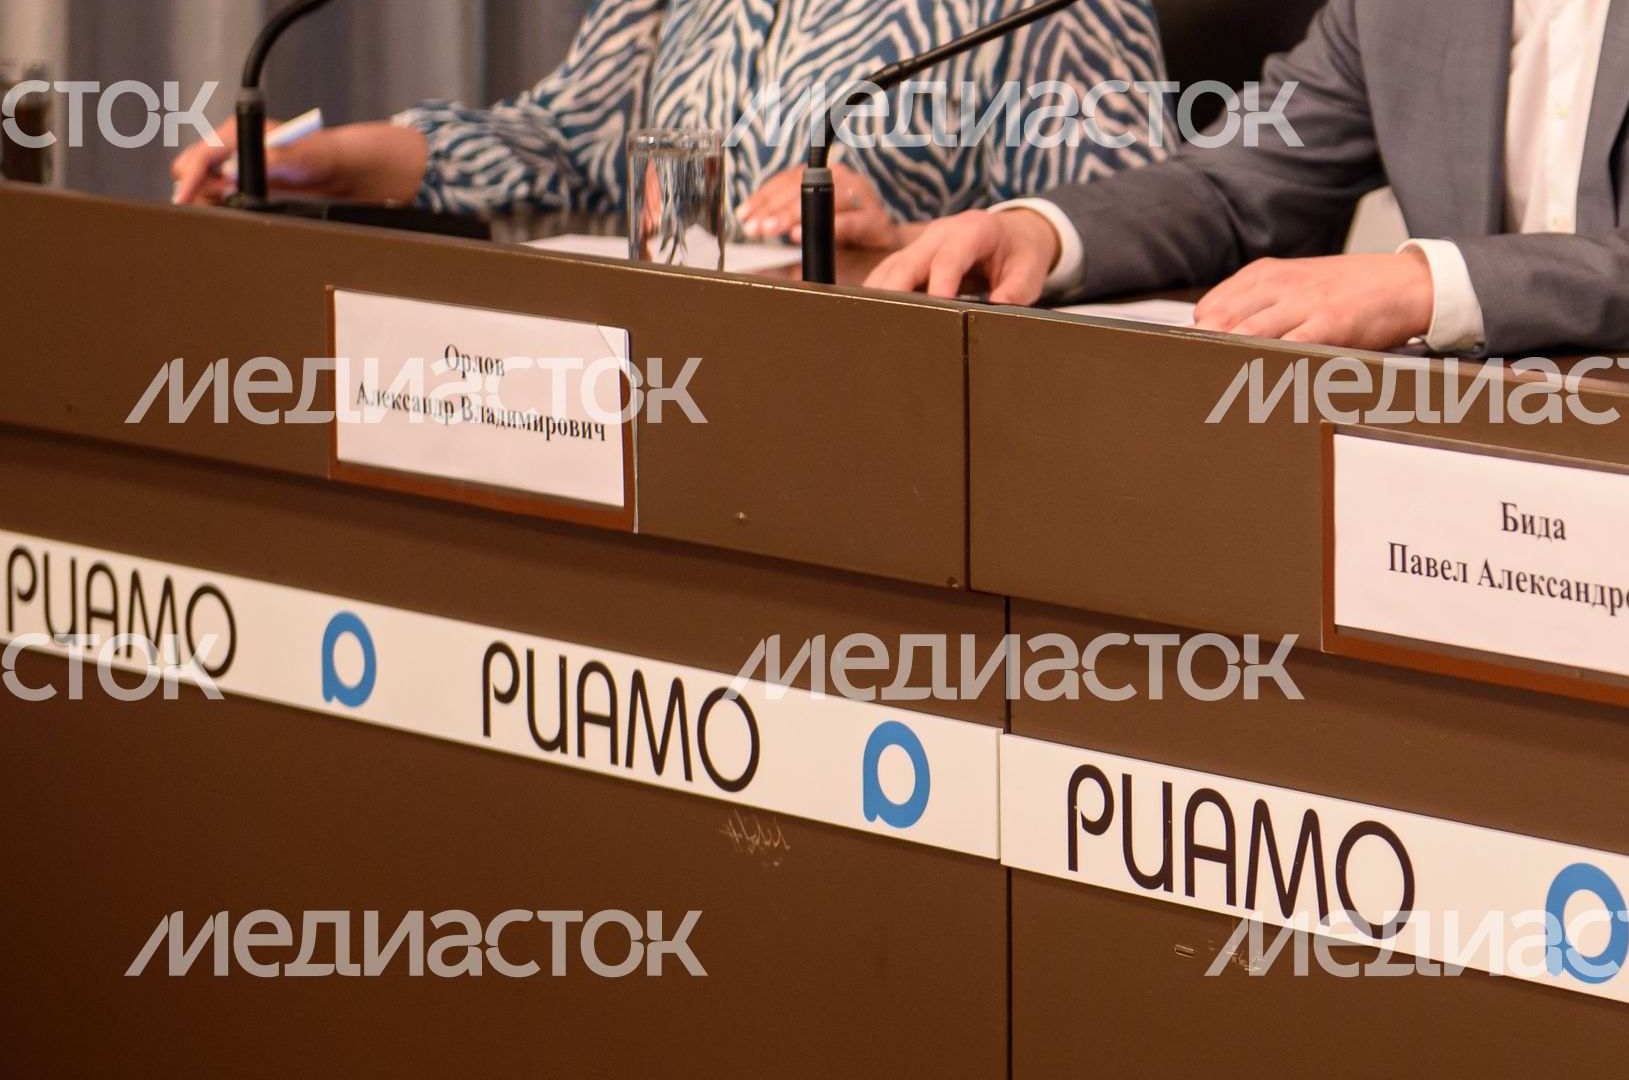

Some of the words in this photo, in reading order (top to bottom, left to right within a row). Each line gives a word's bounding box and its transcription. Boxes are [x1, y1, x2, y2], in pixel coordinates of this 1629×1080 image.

[444, 344, 505, 379] Орлов
[356, 381, 454, 425] Александр
[462, 396, 606, 441] Владимирович
[1500, 501, 1566, 541] Бида
[1388, 541, 1468, 584] Павел
